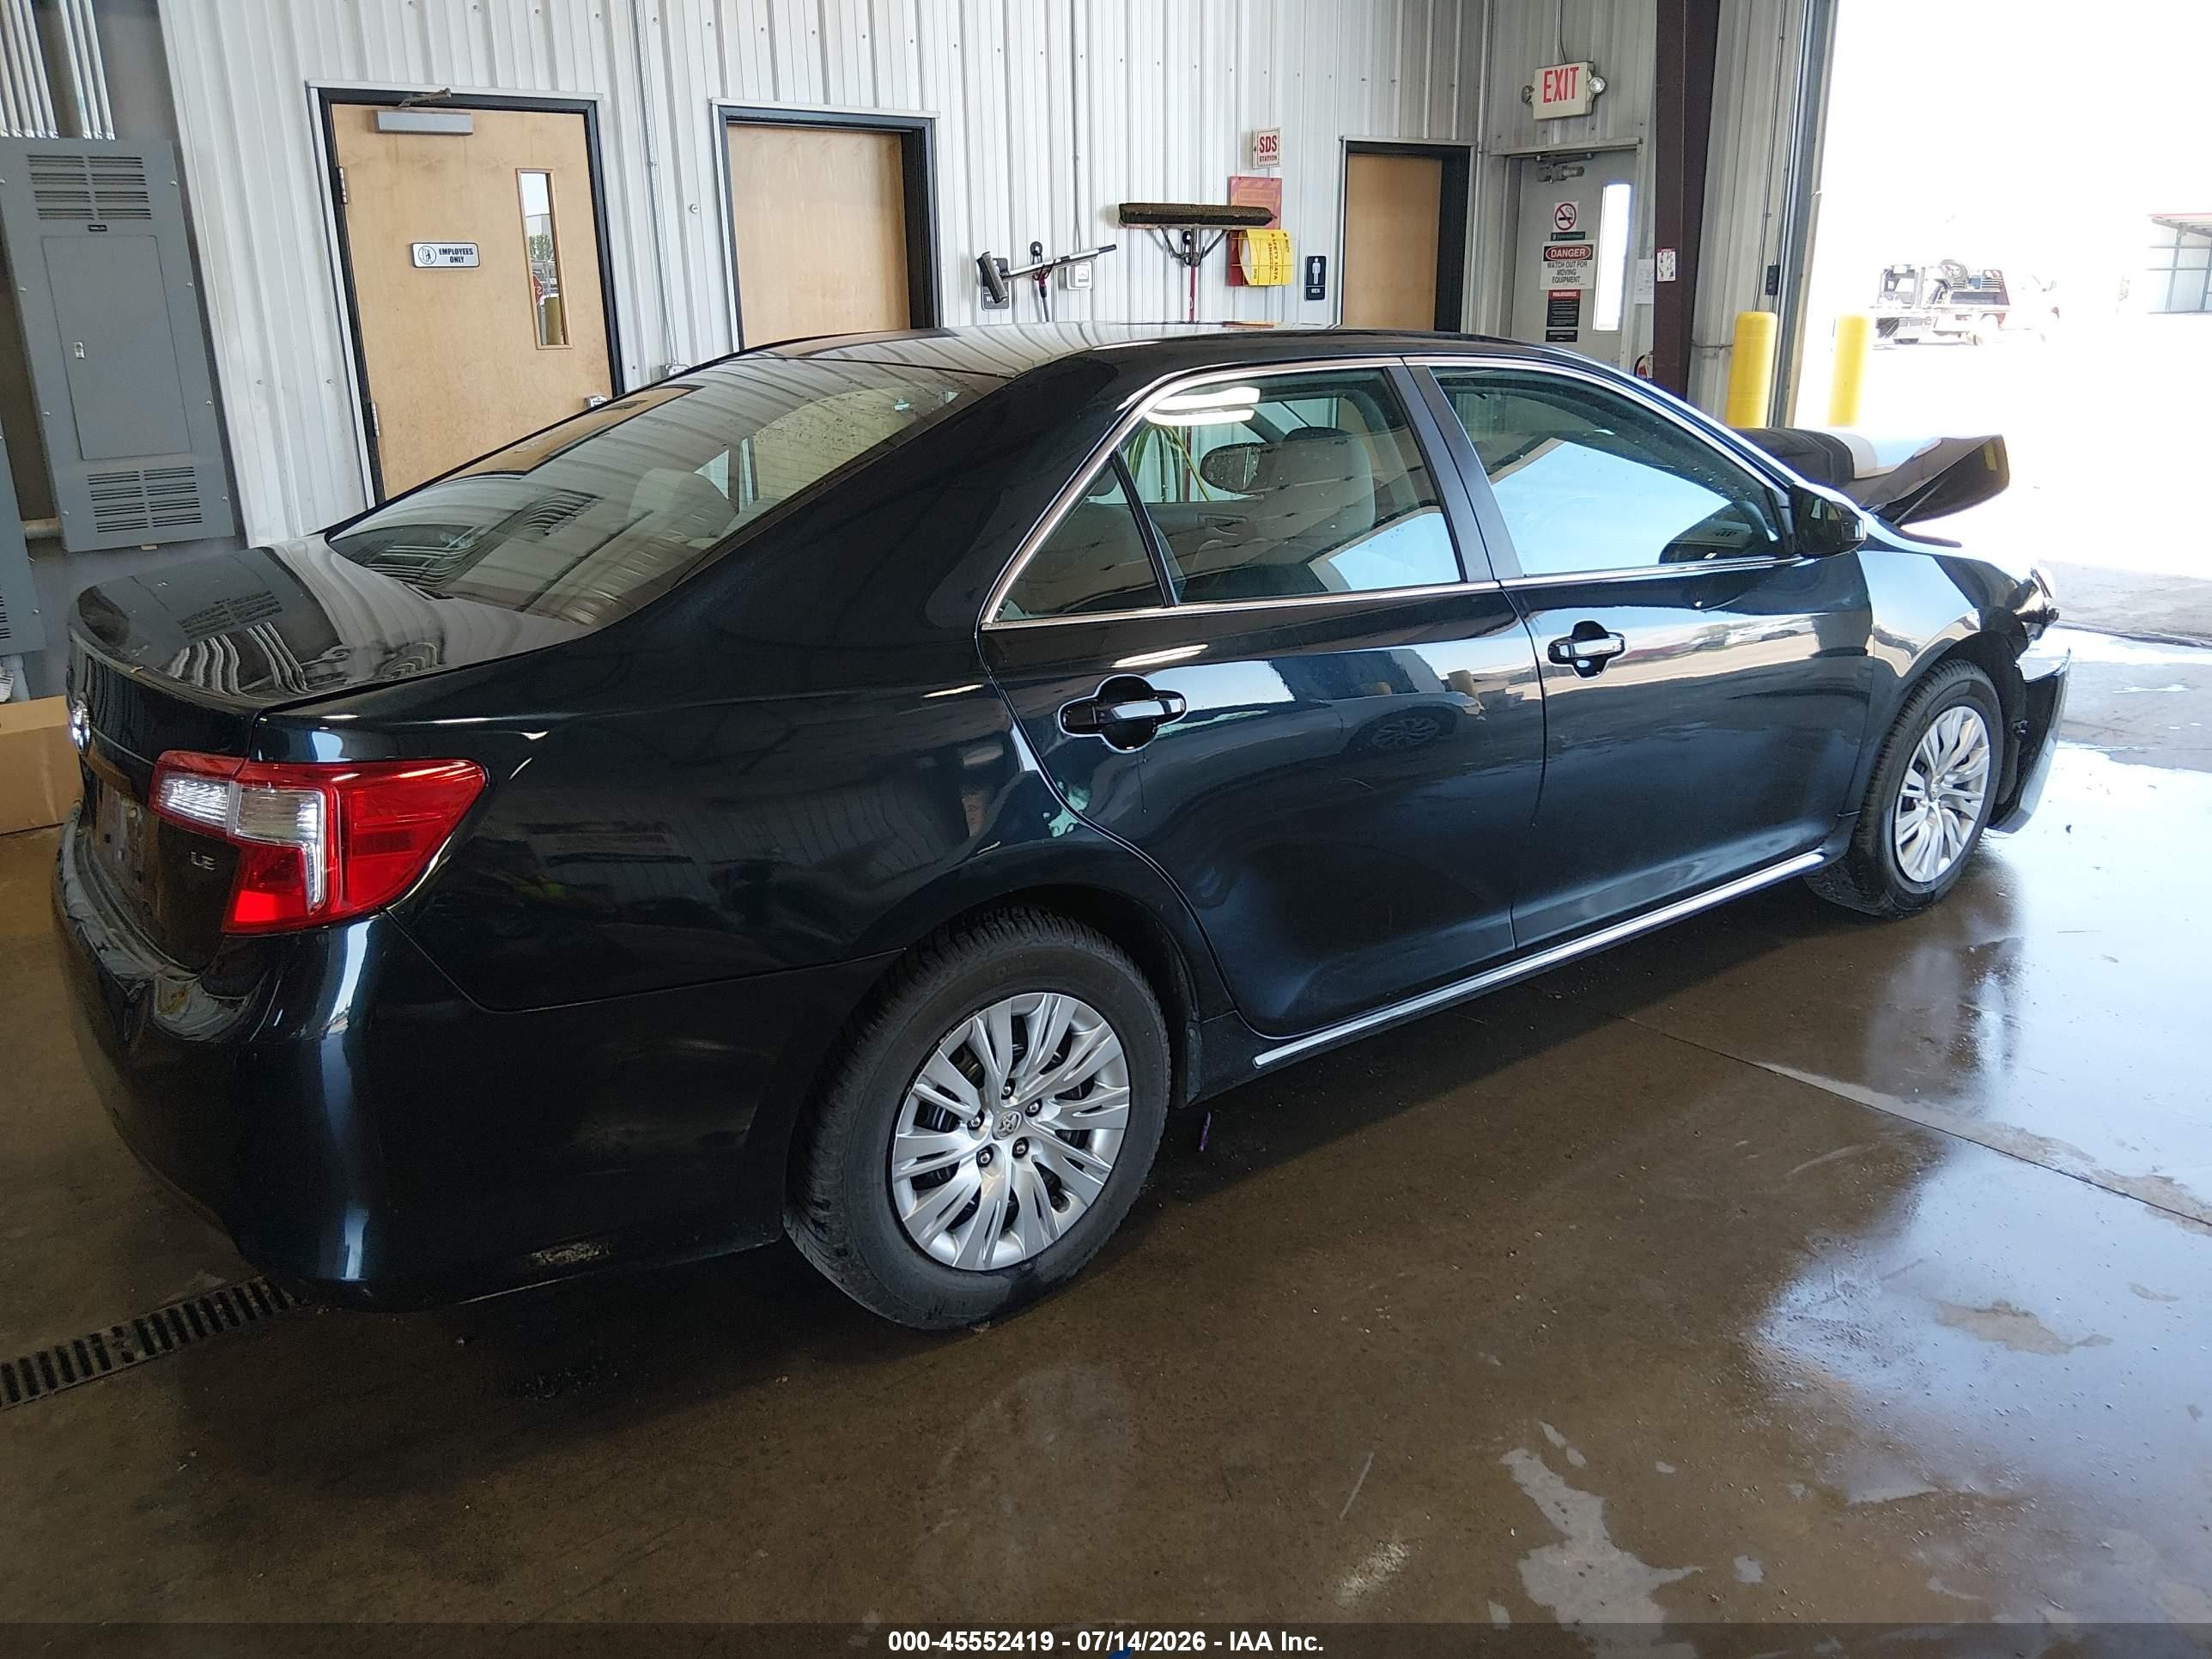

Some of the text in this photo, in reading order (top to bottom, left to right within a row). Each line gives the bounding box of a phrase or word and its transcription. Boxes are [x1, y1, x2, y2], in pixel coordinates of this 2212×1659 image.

[1543, 67, 1579, 103] EXIT
[1259, 135, 1277, 153] SDS
[1551, 248, 1586, 258] DANGER
[191, 851, 216, 871] LE
